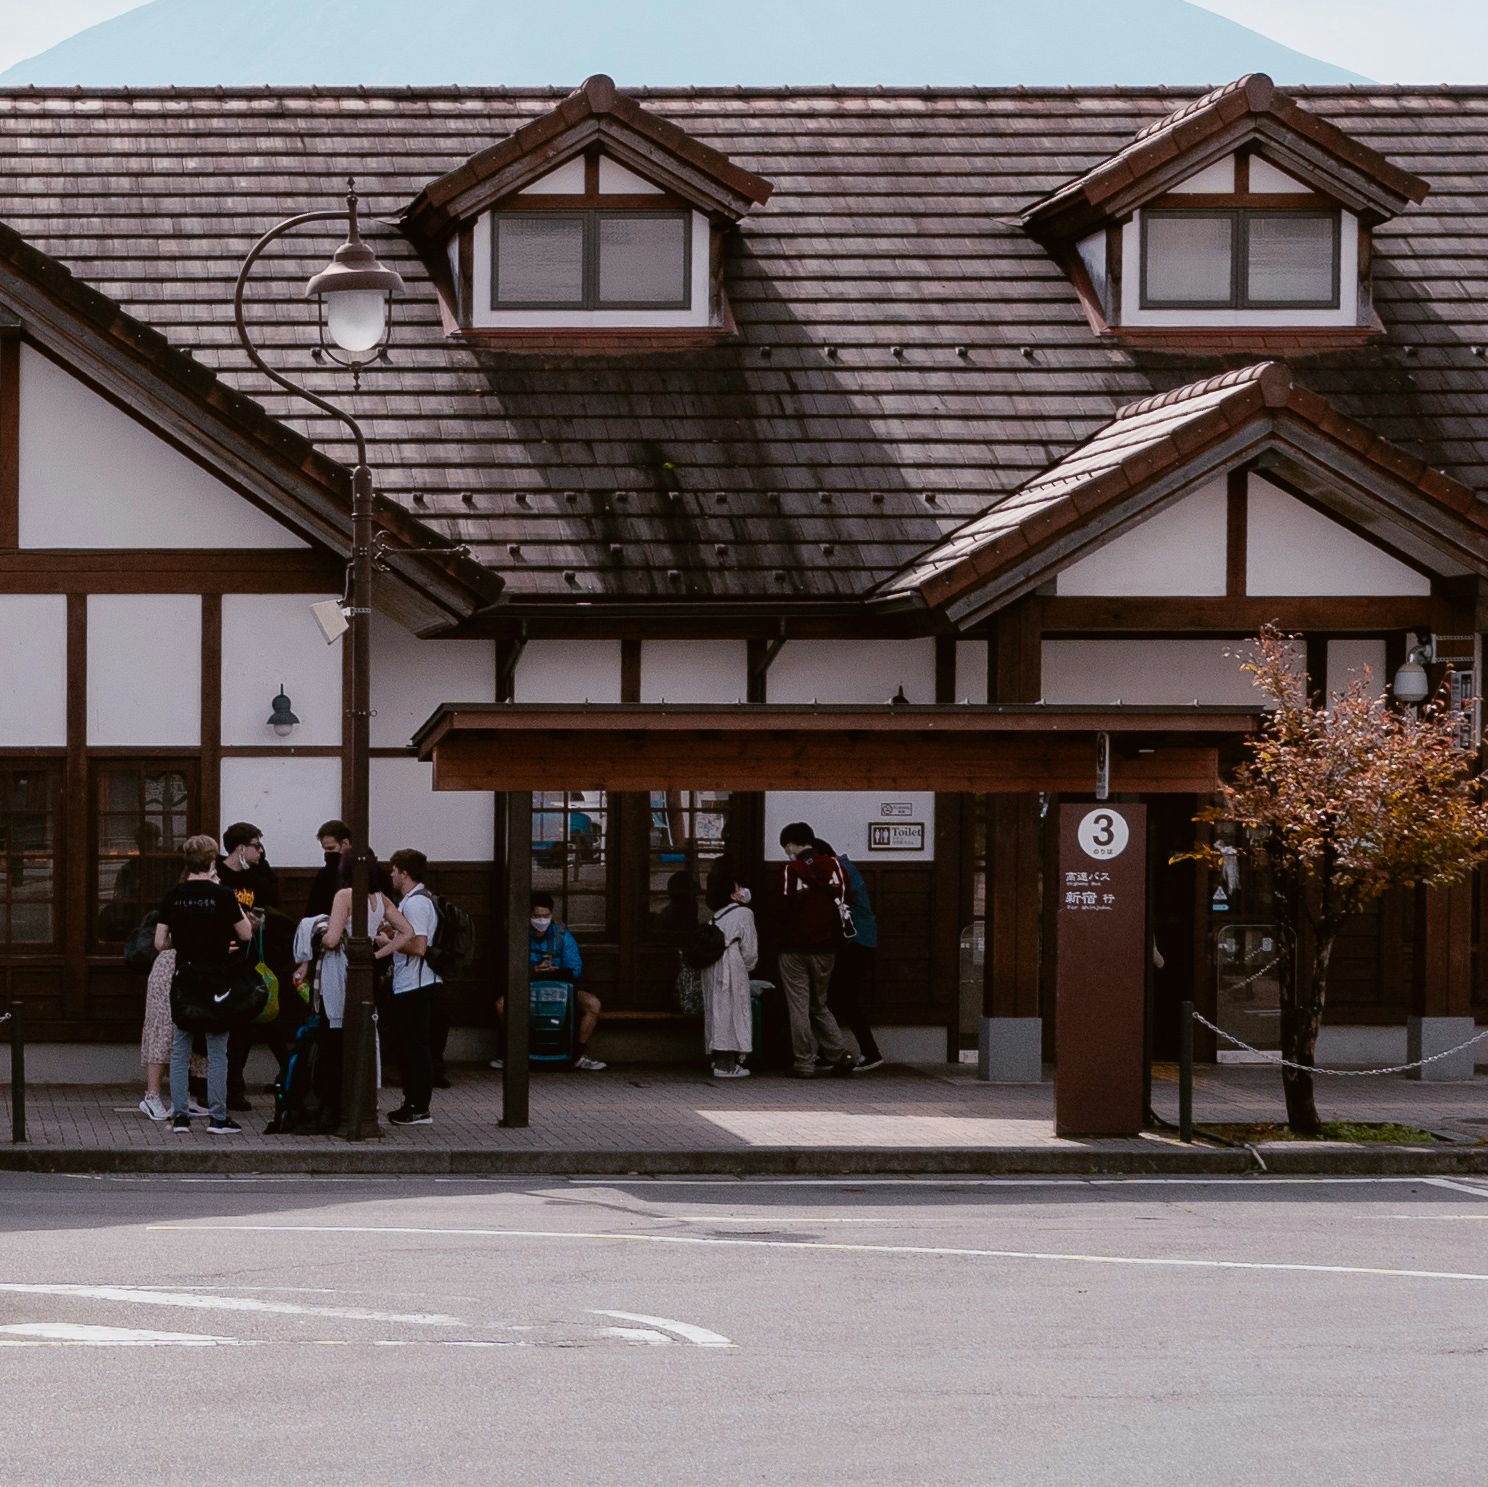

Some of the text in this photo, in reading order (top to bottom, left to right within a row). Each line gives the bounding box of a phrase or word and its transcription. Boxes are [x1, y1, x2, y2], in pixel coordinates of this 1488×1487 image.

[892, 827, 921, 837] Toilet
[1092, 814, 1115, 846] 3
[1065, 872, 1110, 882] 高速バス
[1065, 891, 1115, 904] 新宿 行
